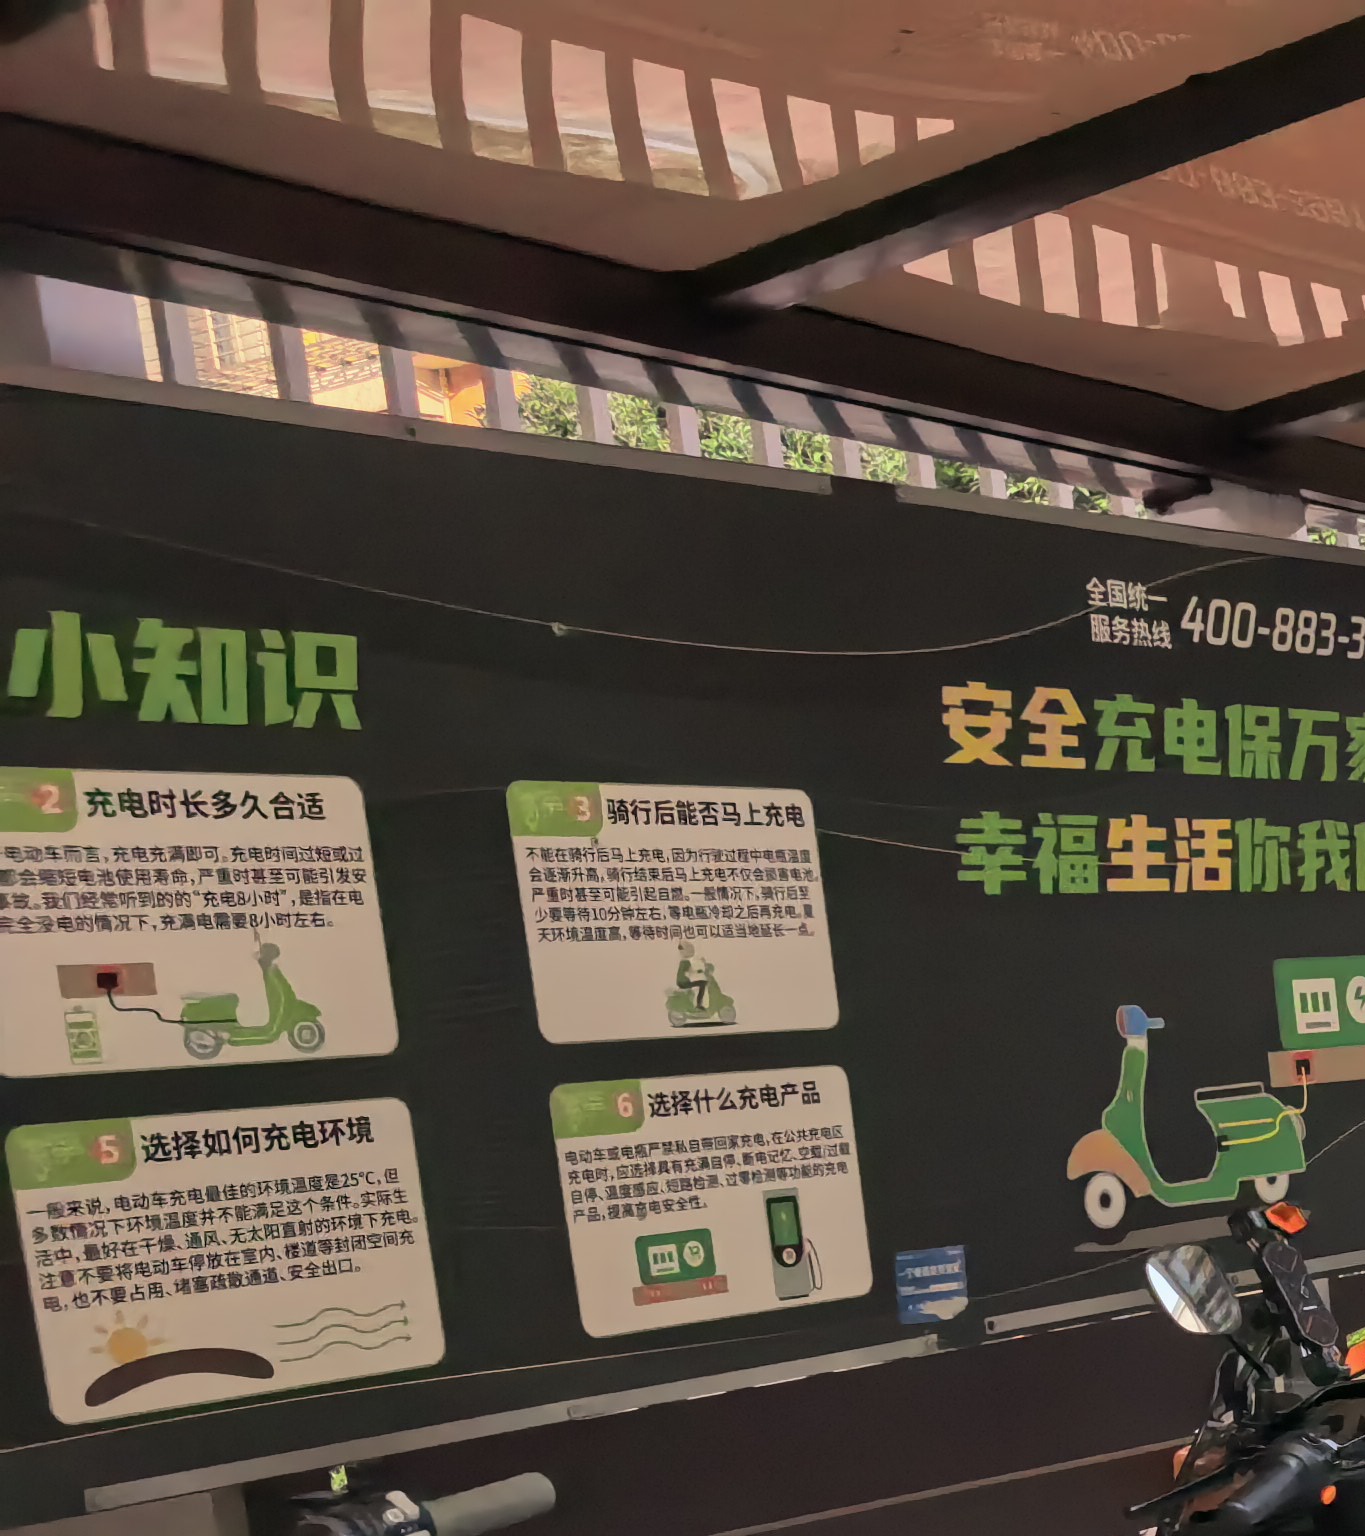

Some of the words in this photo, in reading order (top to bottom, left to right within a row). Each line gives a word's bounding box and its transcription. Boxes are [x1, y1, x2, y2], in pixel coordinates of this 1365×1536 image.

[1086, 577, 1168, 611] 全国统一
[1090, 614, 1173, 649] 服务热线
[8, 610, 362, 730] 小知识
[84, 787, 326, 820] 充电时长多久合适
[607, 799, 805, 827] 骑行后能否马上充电
[617, 1093, 634, 1117] 6
[648, 1080, 821, 1118] 选择什么充电产品
[140, 1116, 375, 1163] 选择如何充电环境
